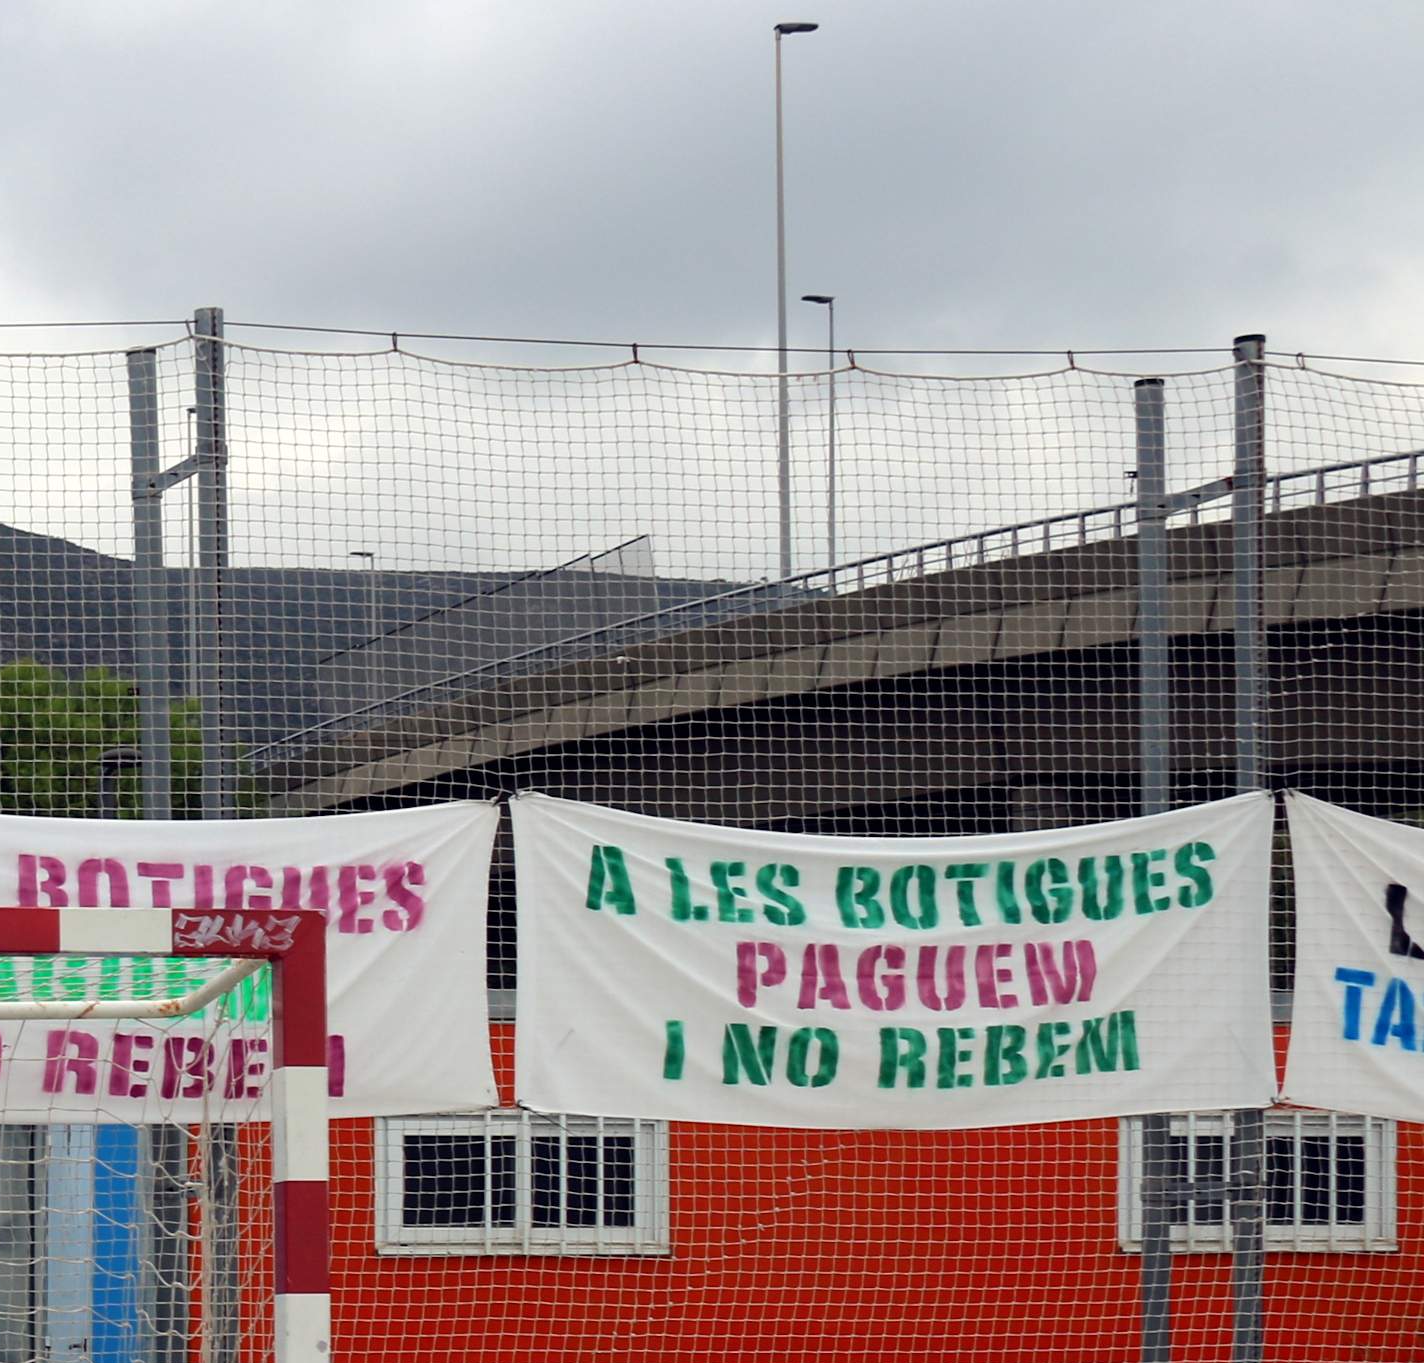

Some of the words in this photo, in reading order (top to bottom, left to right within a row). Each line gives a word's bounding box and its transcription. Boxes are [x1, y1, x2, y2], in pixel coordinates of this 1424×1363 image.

[585, 843, 638, 916] A
[667, 855, 808, 926] LES
[835, 840, 1217, 930] BOTIGUES
[735, 938, 1099, 1012] PAGUEM
[662, 1019, 685, 1081] I
[722, 1023, 840, 1089] NO
[876, 1009, 1141, 1090] REBEM
